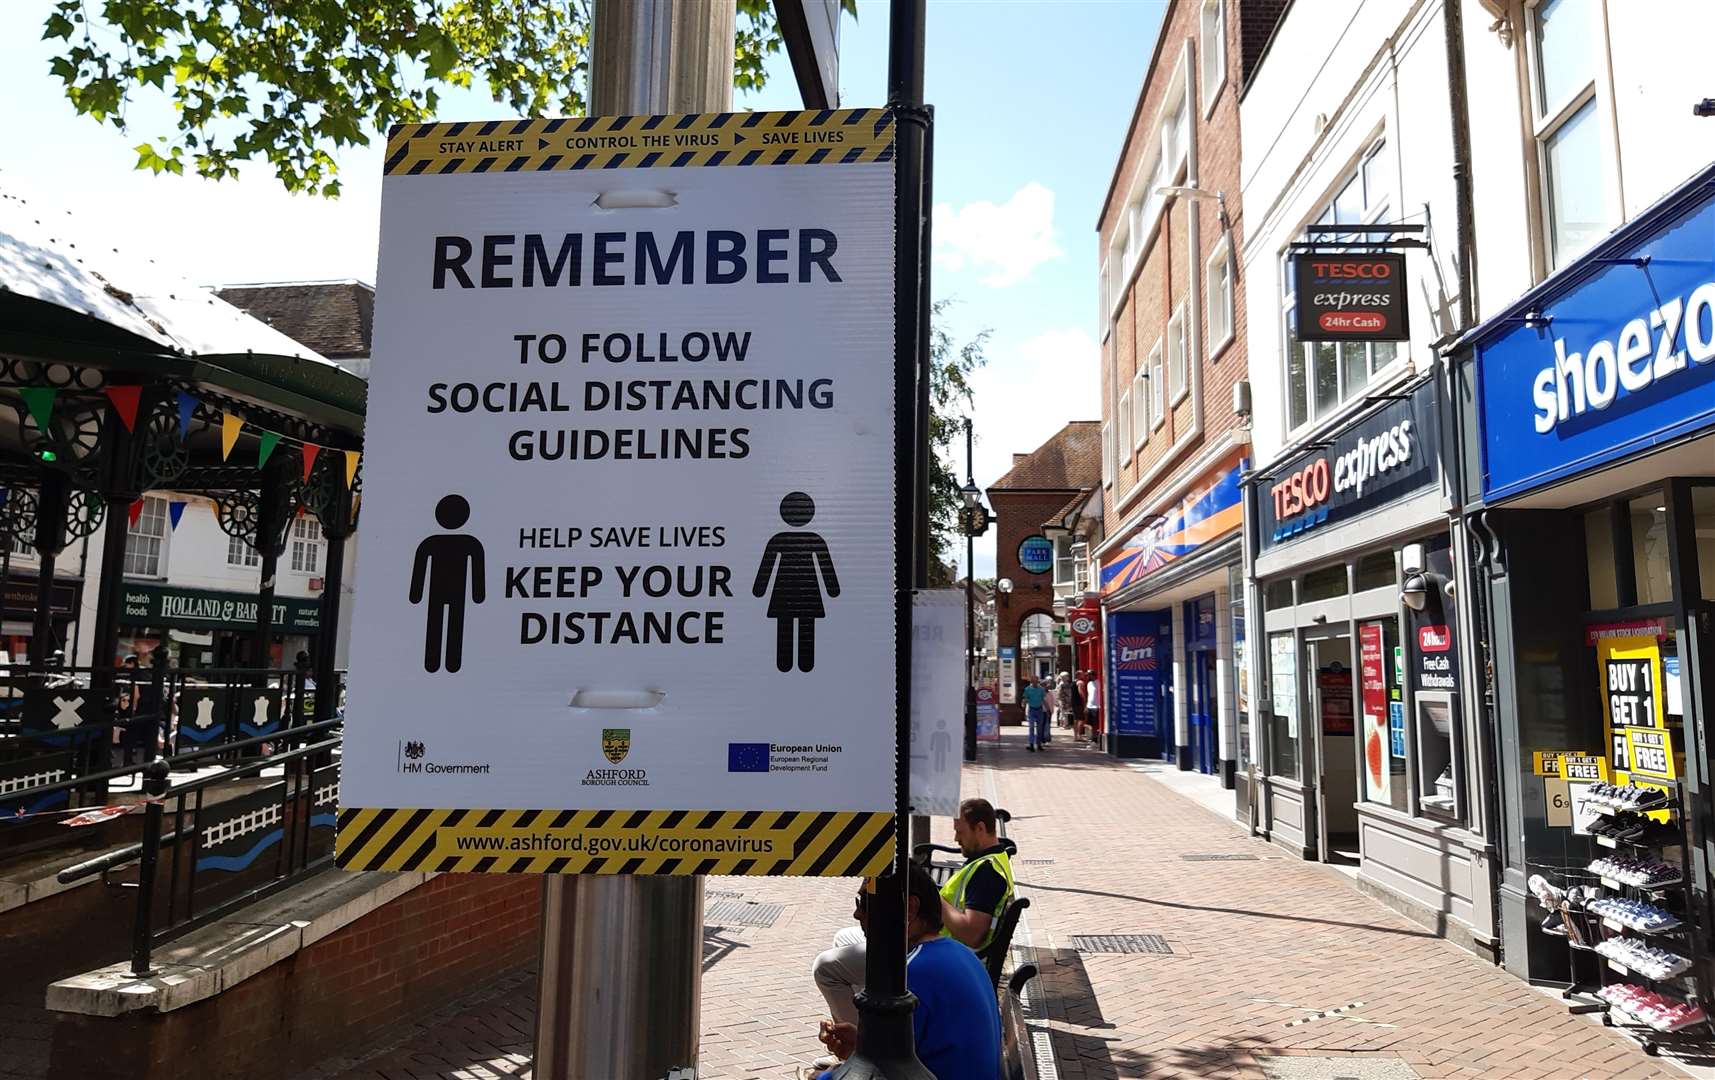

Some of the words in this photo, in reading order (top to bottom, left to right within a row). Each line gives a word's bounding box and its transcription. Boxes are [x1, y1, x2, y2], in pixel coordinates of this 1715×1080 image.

[566, 135, 637, 149] CONTROL
[642, 135, 670, 146] THE
[674, 133, 719, 146] VIRUS
[762, 132, 799, 144] SAVE
[804, 131, 844, 143] LIVES
[439, 142, 475, 153] STAY
[479, 140, 523, 152] ALERT
[432, 228, 842, 289] REMEMBER
[1312, 263, 1390, 278] TESCO
[1313, 291, 1390, 310] express
[1325, 317, 1350, 327] 24hr
[1353, 317, 1381, 327] Cash
[514, 333, 567, 364] TO
[582, 331, 752, 363] FOLLOW
[427, 381, 573, 414] SOCIAL
[583, 378, 834, 412] DISTANCING
[508, 427, 749, 462] GUIDELINES
[1270, 458, 1332, 520] TESCO
[1334, 418, 1412, 498] express
[519, 528, 583, 549] HELP
[589, 527, 651, 548] SAVE
[659, 526, 726, 548] LIVES
[505, 566, 602, 598] KEEP
[615, 565, 733, 598] YOUR
[126, 592, 150, 604] health
[126, 605, 148, 616] foods
[160, 595, 220, 617] HOLLAND
[221, 600, 234, 621] &
[236, 602, 287, 625] BARTT
[298, 608, 319, 616] natural
[520, 611, 724, 645] DISTANCE
[1423, 656, 1435, 670] Free
[1435, 656, 1450, 670] Cash
[1421, 674, 1455, 687] Withdrawals
[1608, 663, 1636, 692] BUY
[1641, 663, 1650, 692] 1
[1611, 694, 1639, 725] GET
[1643, 695, 1653, 726] 1
[770, 744, 813, 754] European
[816, 744, 842, 753] Union
[801, 756, 829, 764] Regional
[1635, 746, 1666, 771] FREE
[403, 763, 422, 773] HM
[425, 763, 490, 774] Government
[586, 769, 646, 780] ASHFORD
[1567, 765, 1598, 777] FREE
[1553, 794, 1570, 809] 6.9
[457, 832, 773, 858] www.ashford.gov.uk/coronavirus
